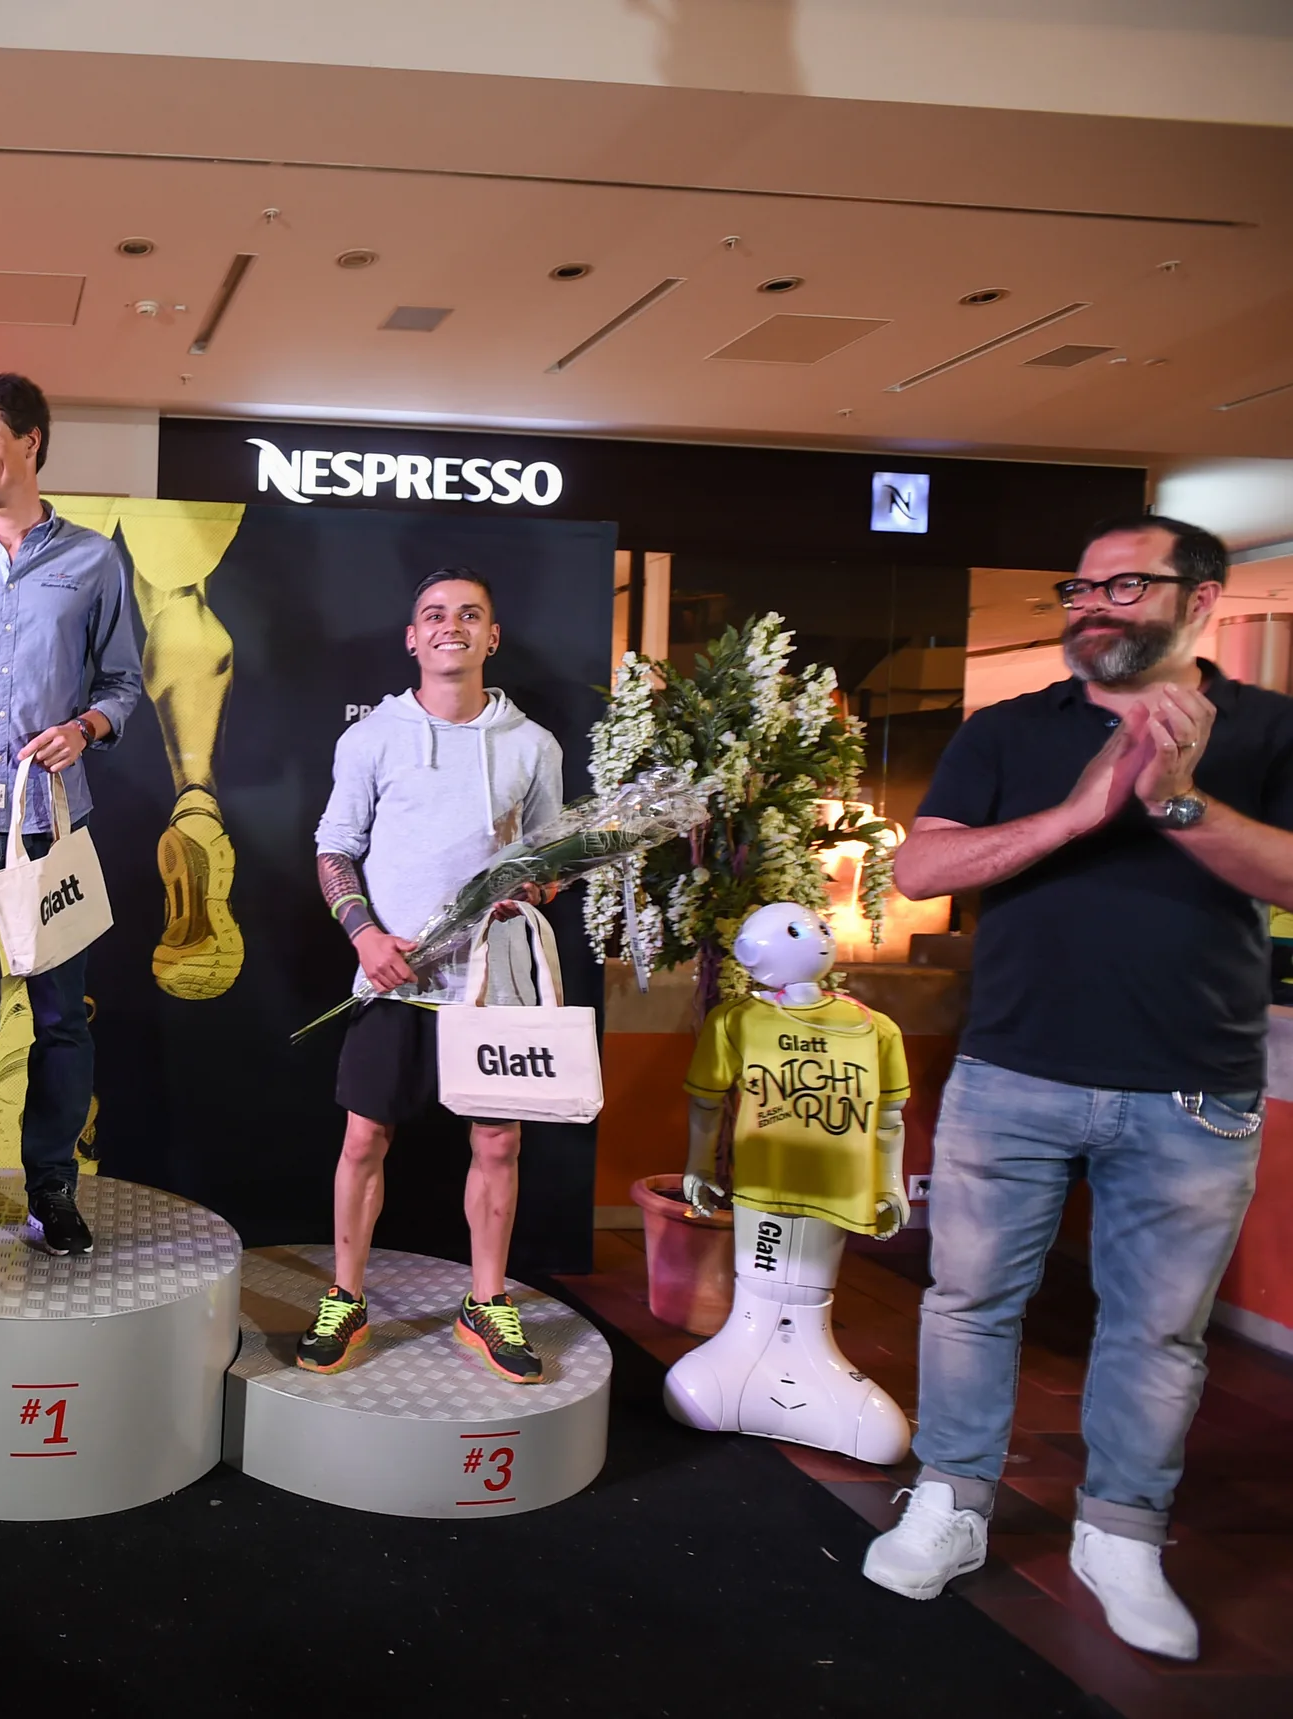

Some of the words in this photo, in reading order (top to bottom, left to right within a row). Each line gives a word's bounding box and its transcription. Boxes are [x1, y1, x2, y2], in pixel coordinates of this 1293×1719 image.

[244, 438, 564, 506] NESPRESSO
[882, 484, 918, 520] N
[40, 874, 84, 926] Glatt
[476, 1044, 555, 1077] Glatt
[778, 1034, 829, 1053] Glatt
[748, 1058, 869, 1107] NIGHT
[758, 1111, 792, 1128] EDITION
[793, 1093, 874, 1135] RUN
[754, 1220, 782, 1272] Glatt
[19, 1398, 69, 1444] #1
[463, 1446, 515, 1491] #3
